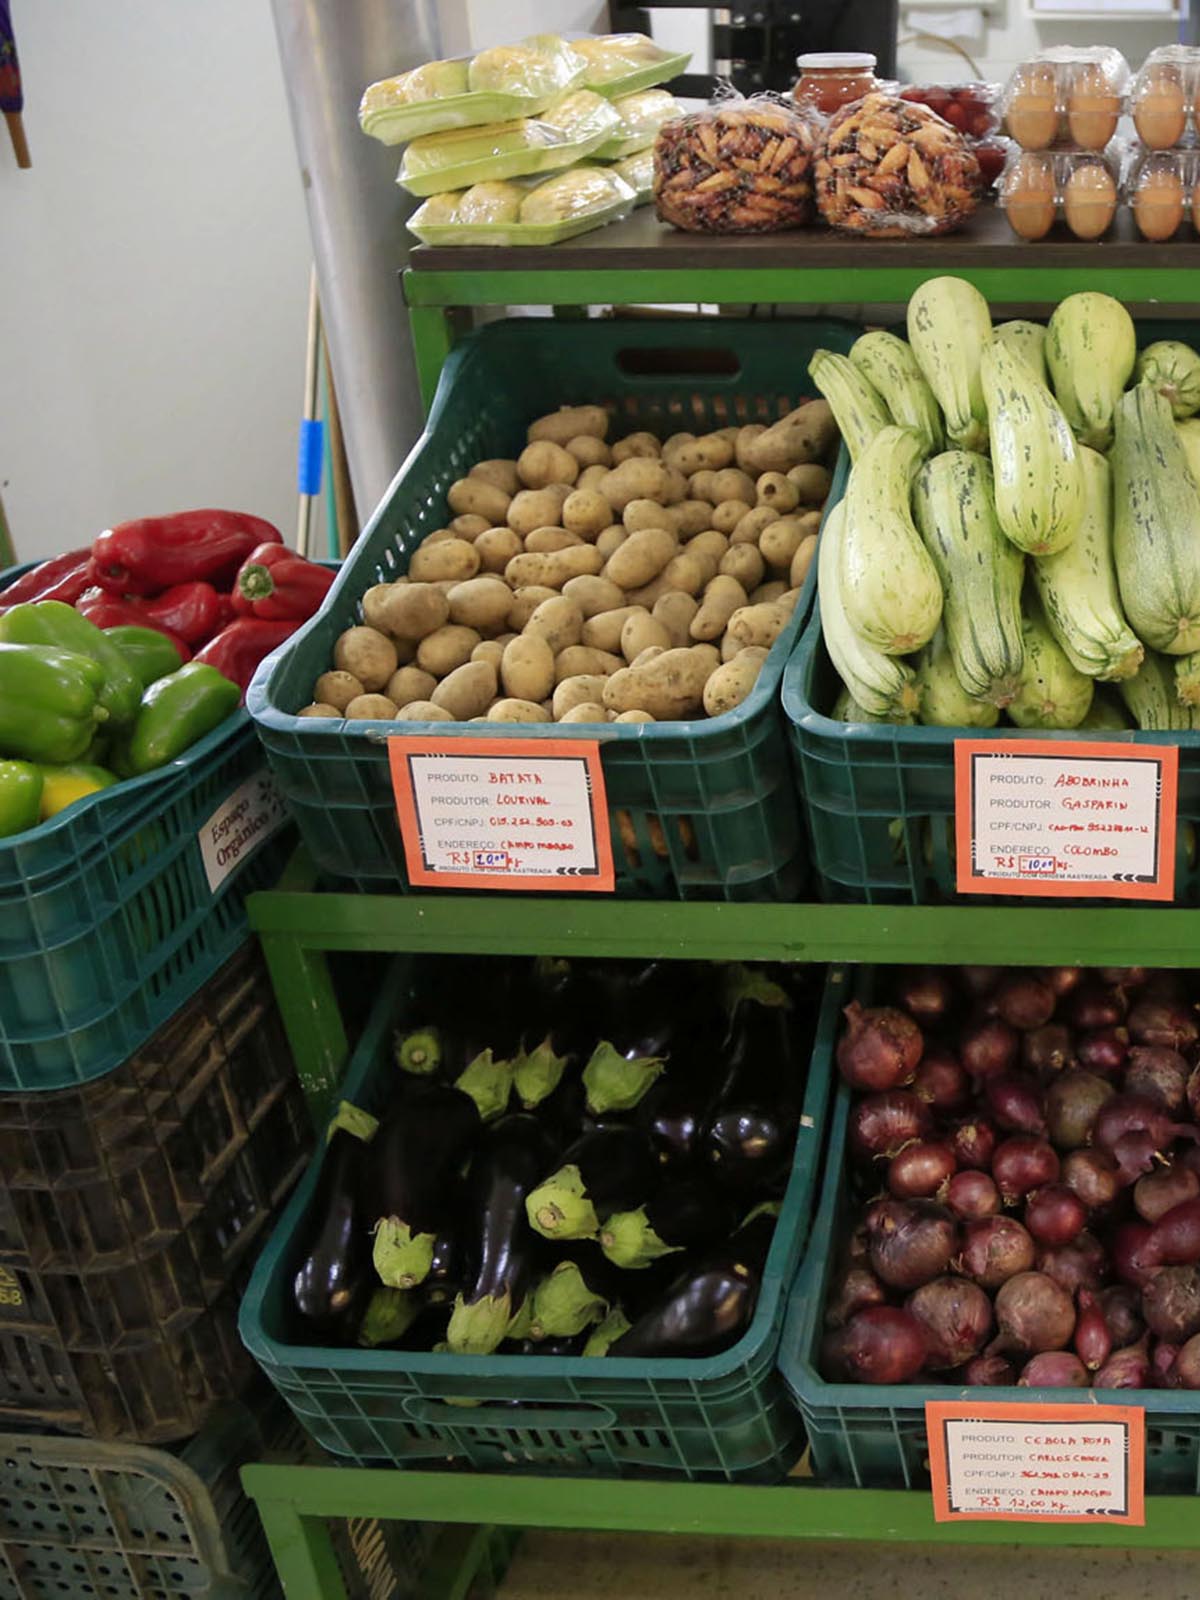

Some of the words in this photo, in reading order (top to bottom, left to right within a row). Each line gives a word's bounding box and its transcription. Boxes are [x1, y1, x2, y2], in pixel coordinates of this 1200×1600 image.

[488, 773, 542, 785] BATATA
[1055, 774, 1129, 788] ABOBRINHA
[497, 794, 551, 806] LOURIVAL
[212, 800, 250, 845] Espaço
[217, 811, 269, 866] Orgânico
[1064, 845, 1119, 856] COLOMBO
[447, 852, 471, 865] R$
[995, 857, 1015, 868] R$
[1024, 1436, 1077, 1445] CEBOLA
[1029, 1454, 1071, 1462] CARLOS
[977, 1496, 1001, 1508] R$
[1009, 1498, 1046, 1509] 12,00
